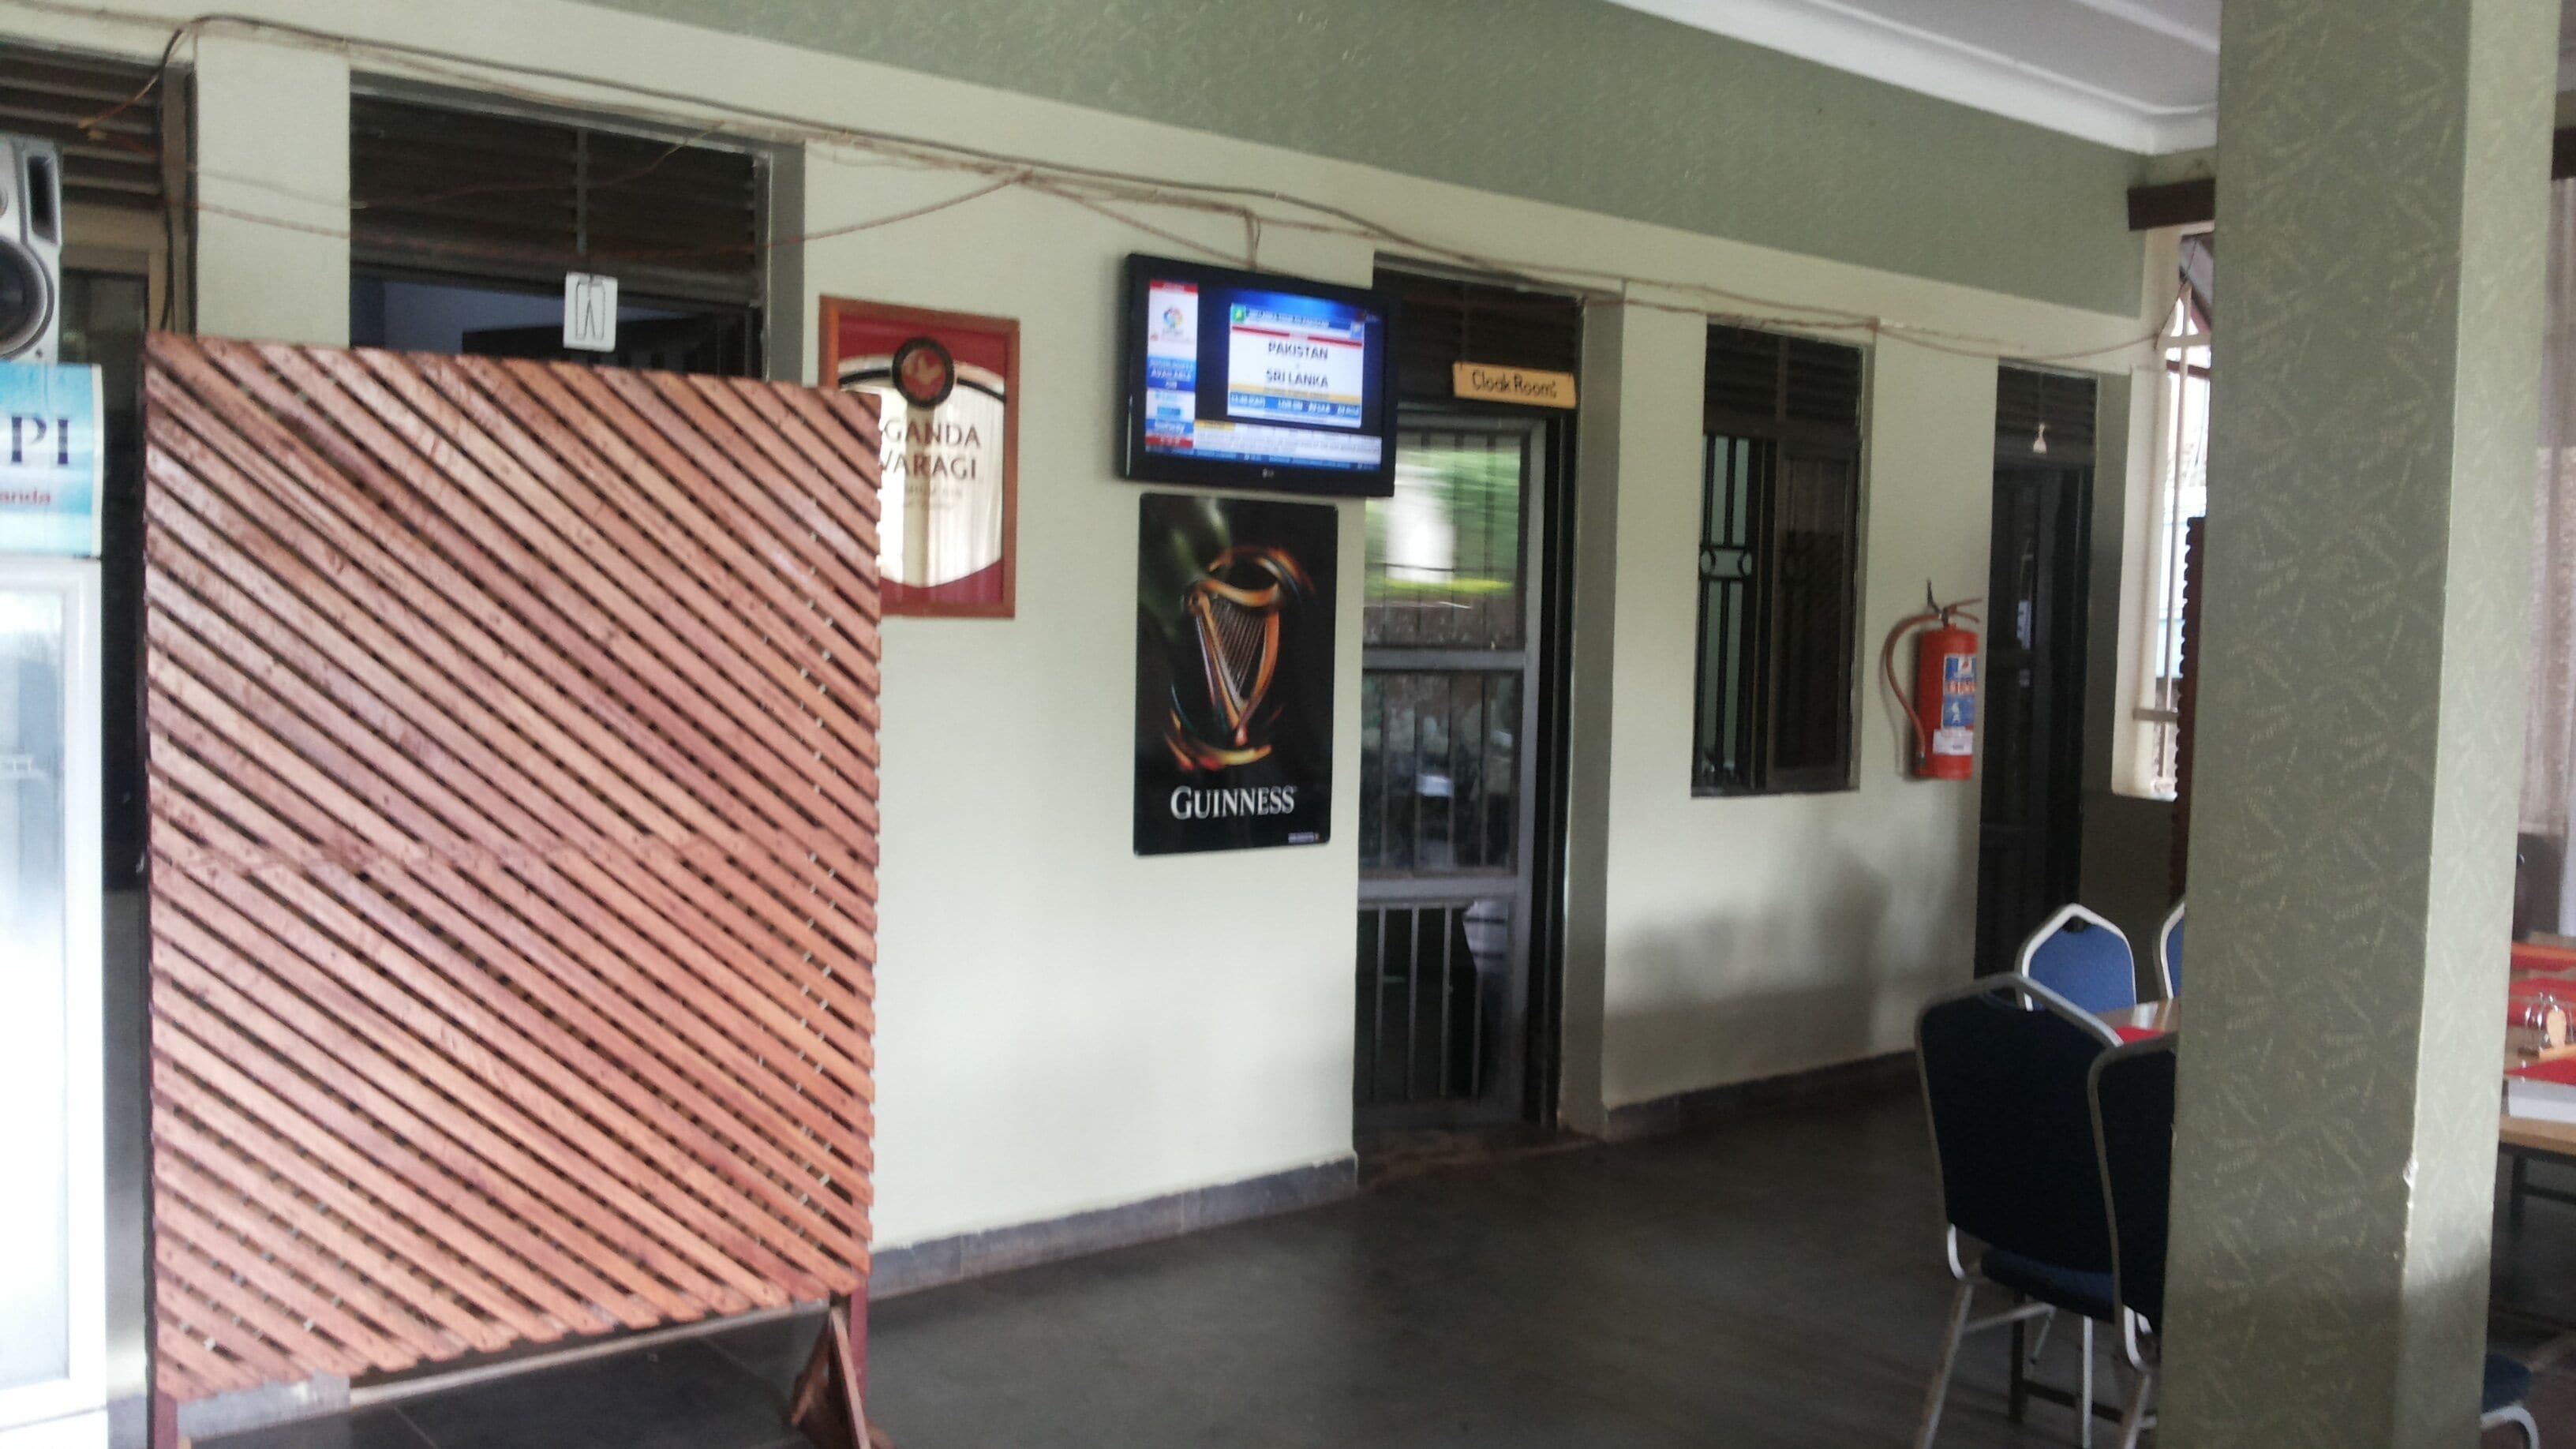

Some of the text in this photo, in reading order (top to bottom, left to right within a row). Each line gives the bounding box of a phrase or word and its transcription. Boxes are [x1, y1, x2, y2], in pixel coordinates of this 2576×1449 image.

[1267, 341, 1329, 361] PAKISTAN
[1266, 367, 1329, 388] SRI LANKA
[1472, 369, 1511, 393] Cloak
[11, 414, 69, 465] PI
[882, 417, 980, 448] GANDA
[1170, 785, 1295, 820] GUINNESS
